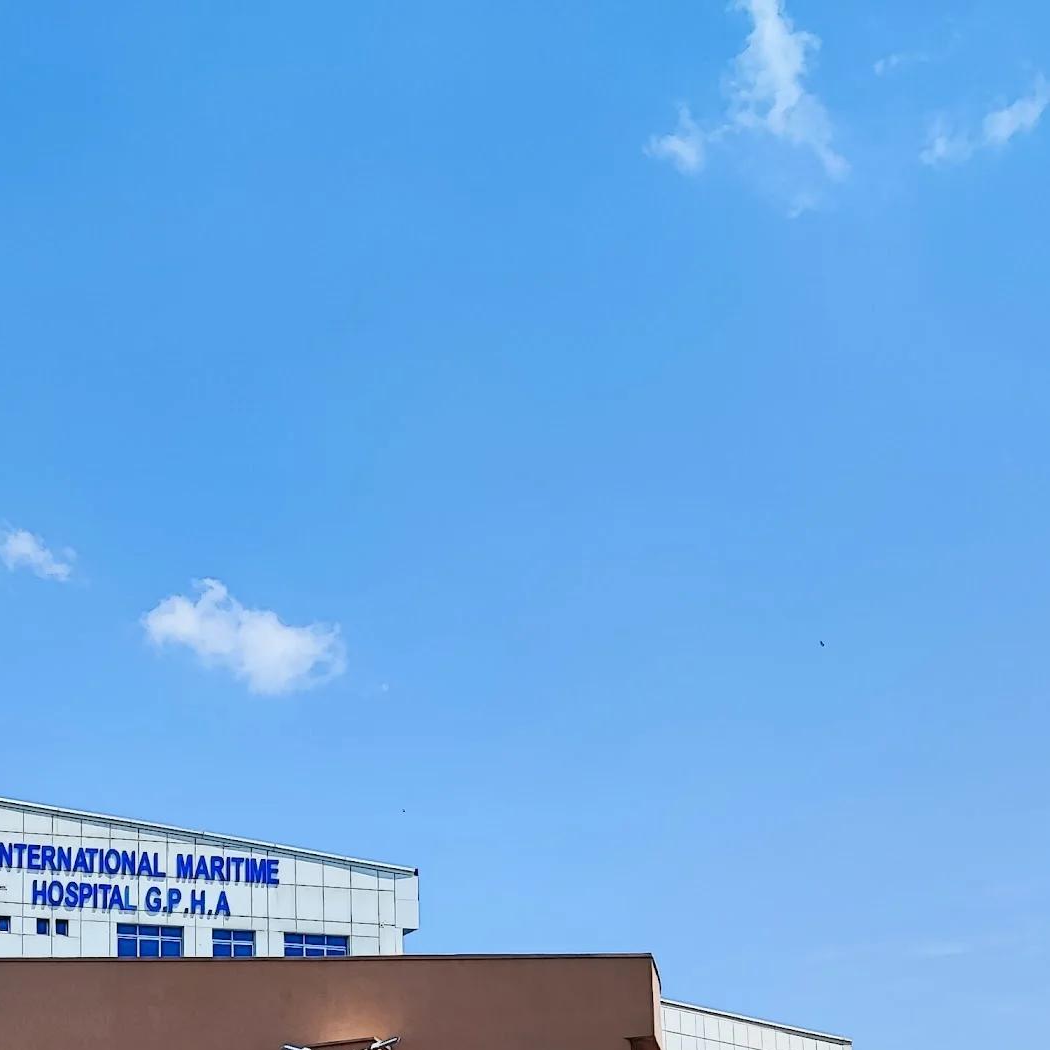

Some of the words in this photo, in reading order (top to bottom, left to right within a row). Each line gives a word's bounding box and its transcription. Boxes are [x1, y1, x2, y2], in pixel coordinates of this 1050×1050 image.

[176, 853, 280, 885] MARITIME
[32, 879, 138, 912] HOSPITAL
[145, 886, 231, 917] G.P.H.A
